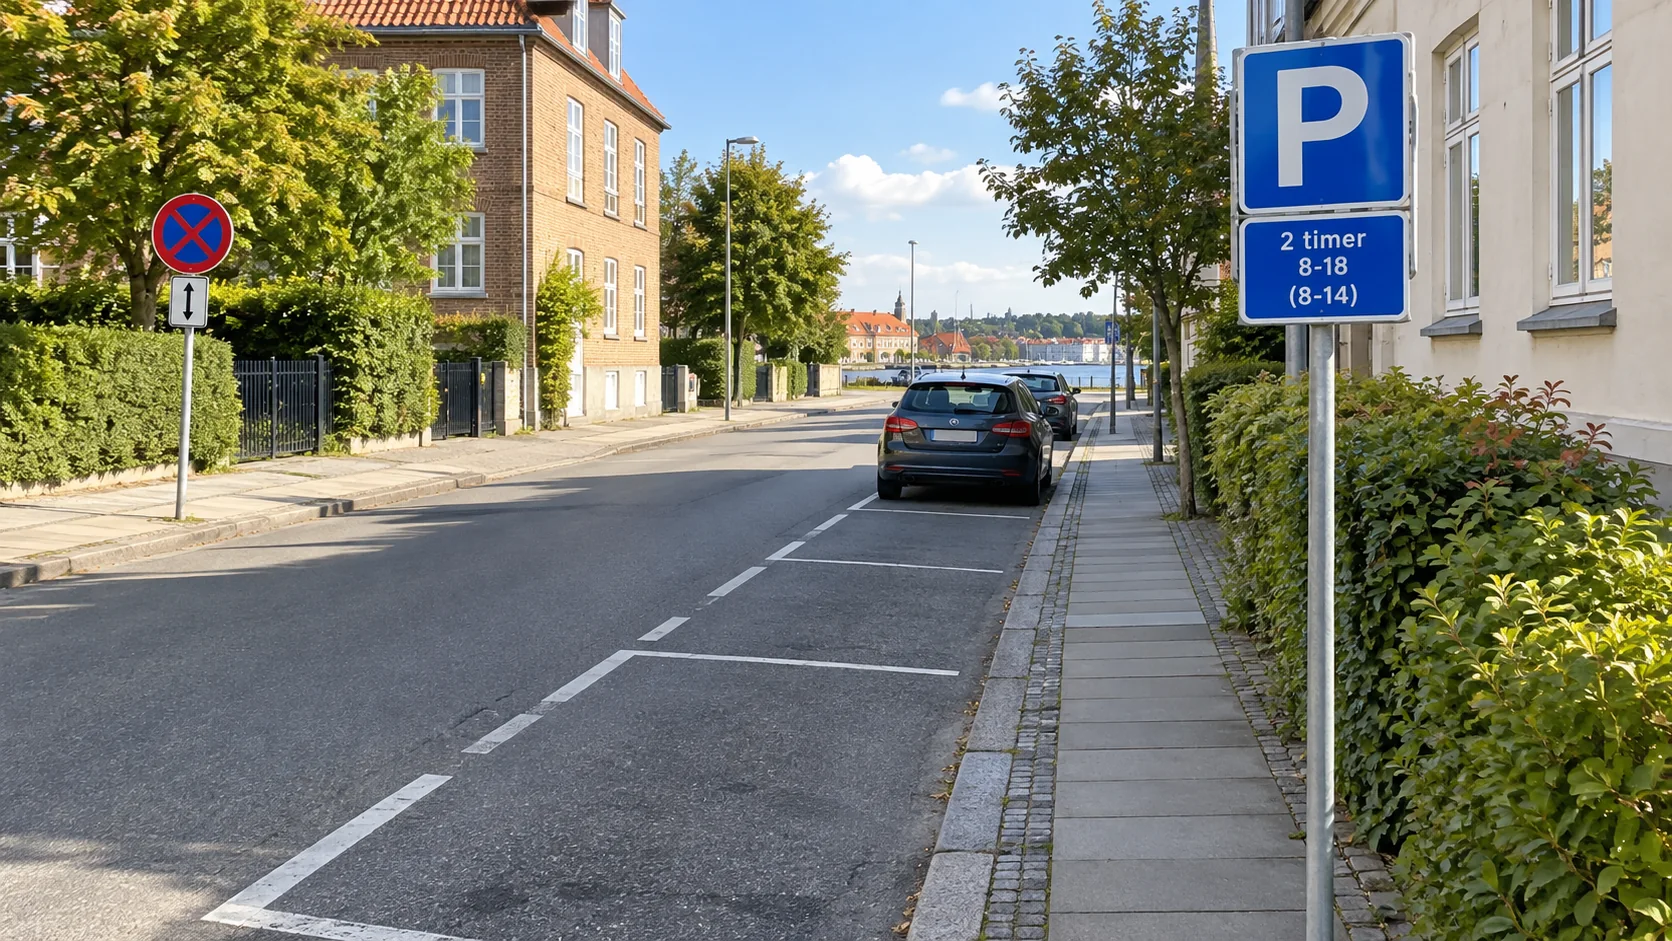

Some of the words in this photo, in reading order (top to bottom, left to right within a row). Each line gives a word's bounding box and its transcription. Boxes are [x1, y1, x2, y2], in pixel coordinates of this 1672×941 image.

[1277, 65, 1369, 188] P
[1280, 231, 1294, 251] 2
[1303, 229, 1367, 250] timer
[1298, 256, 1348, 277] 8-18
[1289, 283, 1358, 309] (8-14)
